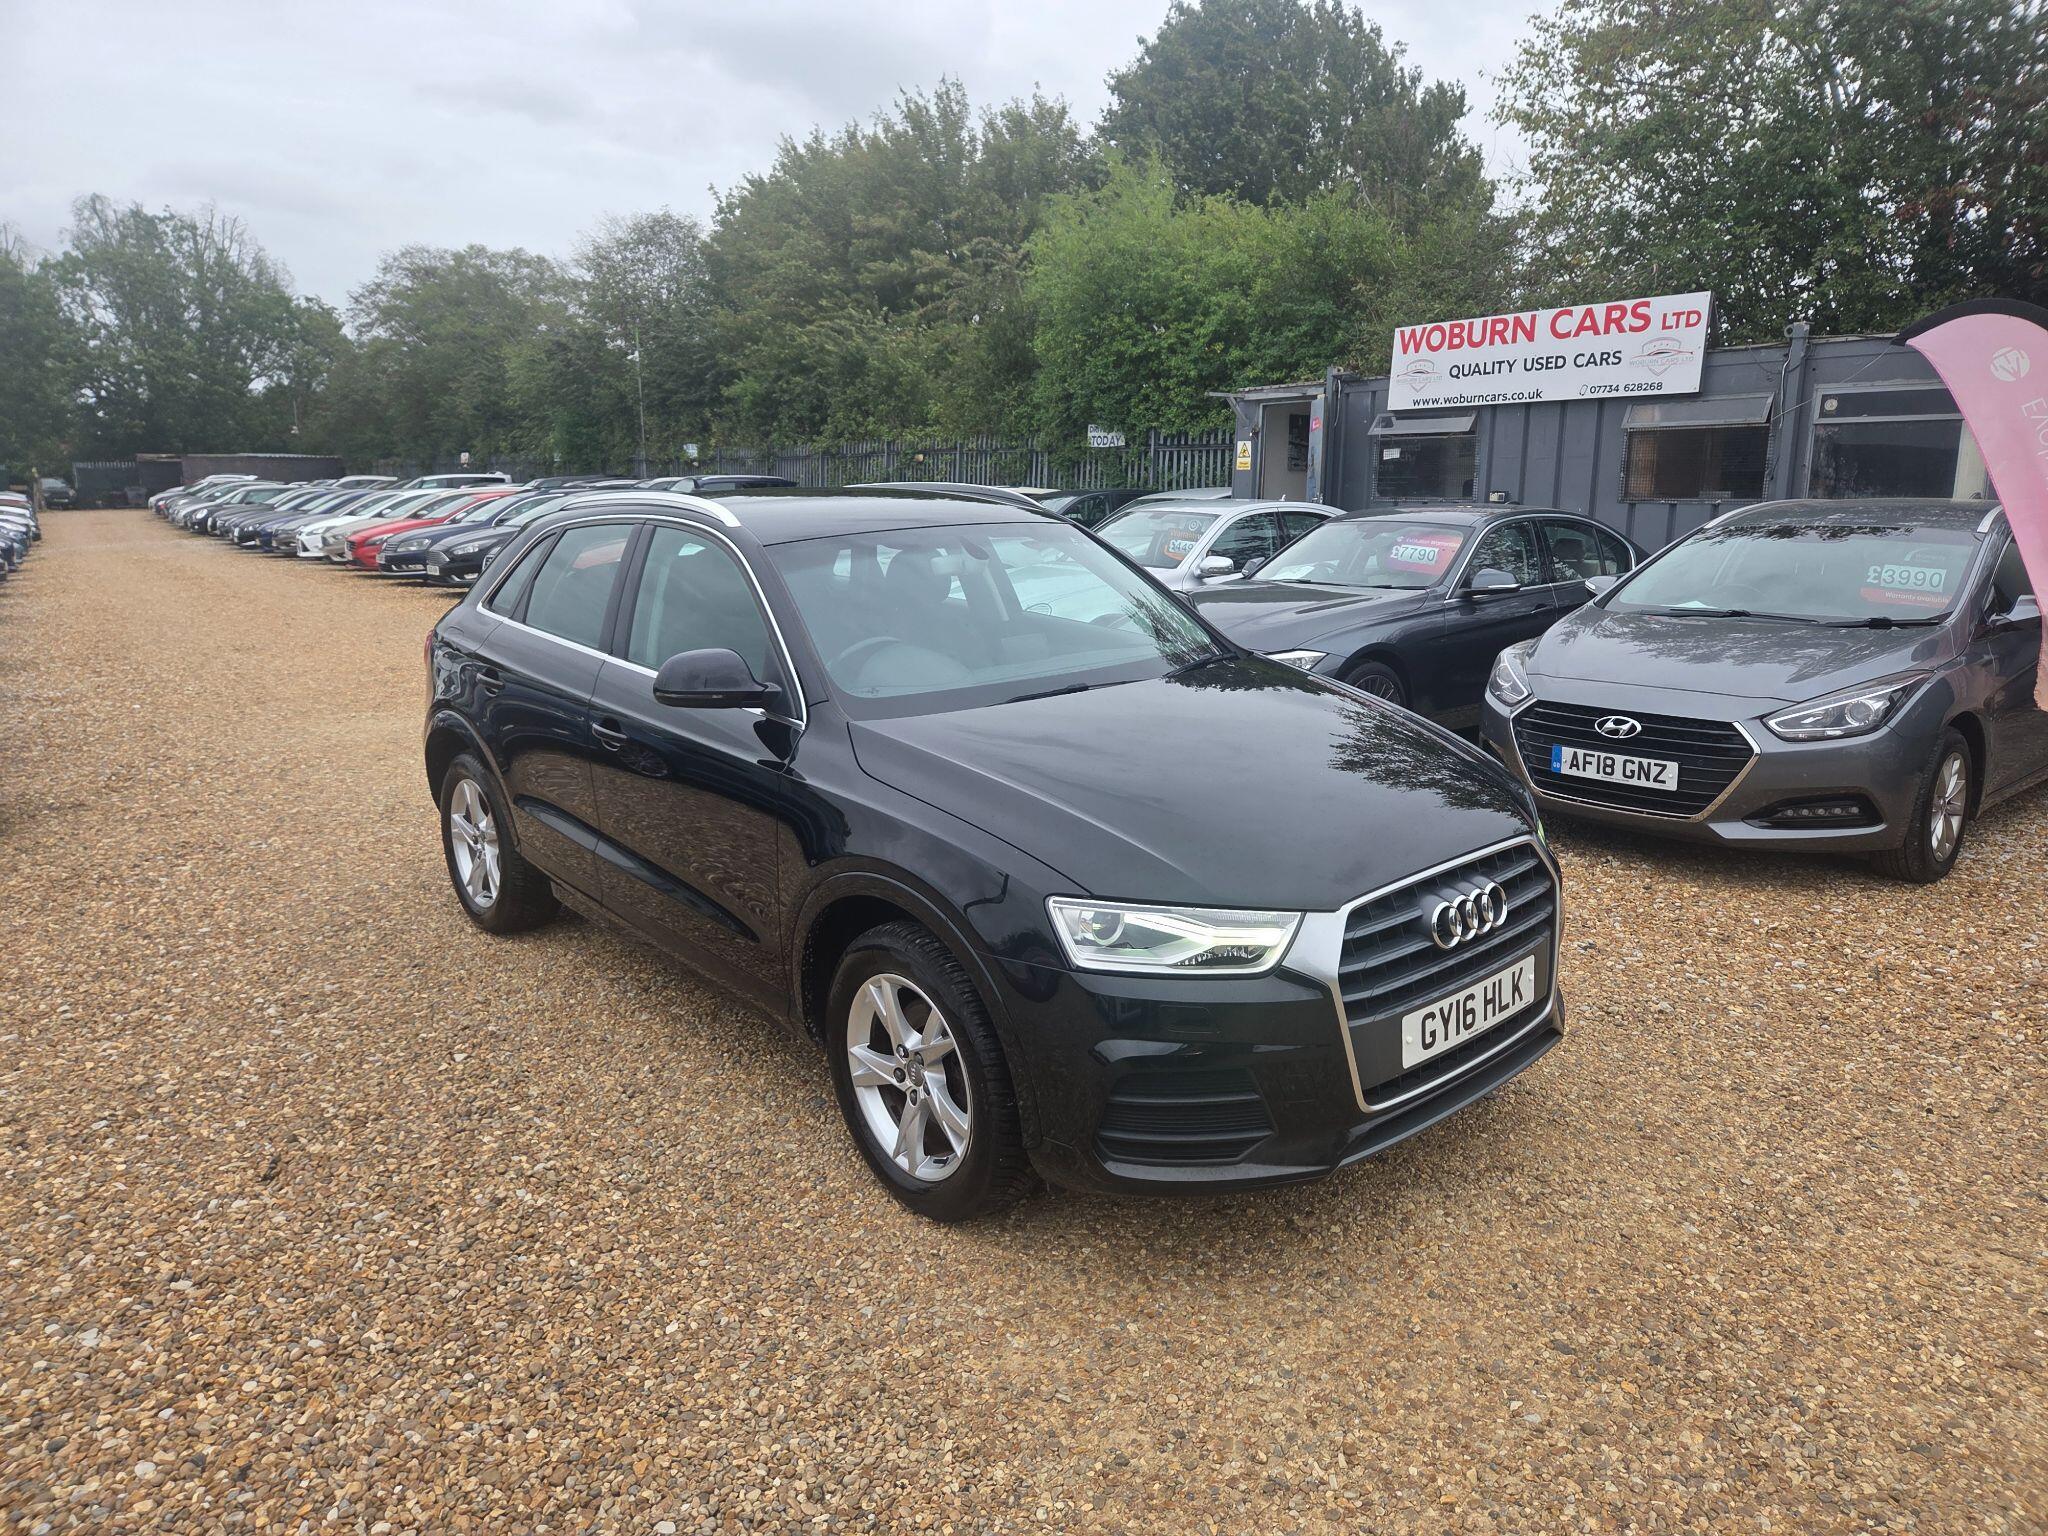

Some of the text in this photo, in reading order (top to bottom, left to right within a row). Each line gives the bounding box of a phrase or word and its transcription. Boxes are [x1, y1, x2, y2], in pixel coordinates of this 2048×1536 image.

[1399, 300, 1702, 355] WOBURN CARS LTD
[1448, 350, 1622, 381] QUALITY USED CARS
[1412, 388, 1543, 407] www.woburncars.co.uk
[1589, 381, 1664, 395] 07734 628268
[1091, 435, 1121, 446] TODAY
[1390, 544, 1436, 562] £7790
[1866, 565, 1943, 588] £3990
[1885, 591, 1916, 601] Warranty
[1569, 750, 1668, 785] AF18 GNZ
[1421, 966, 1524, 1051] GY16 HLK
